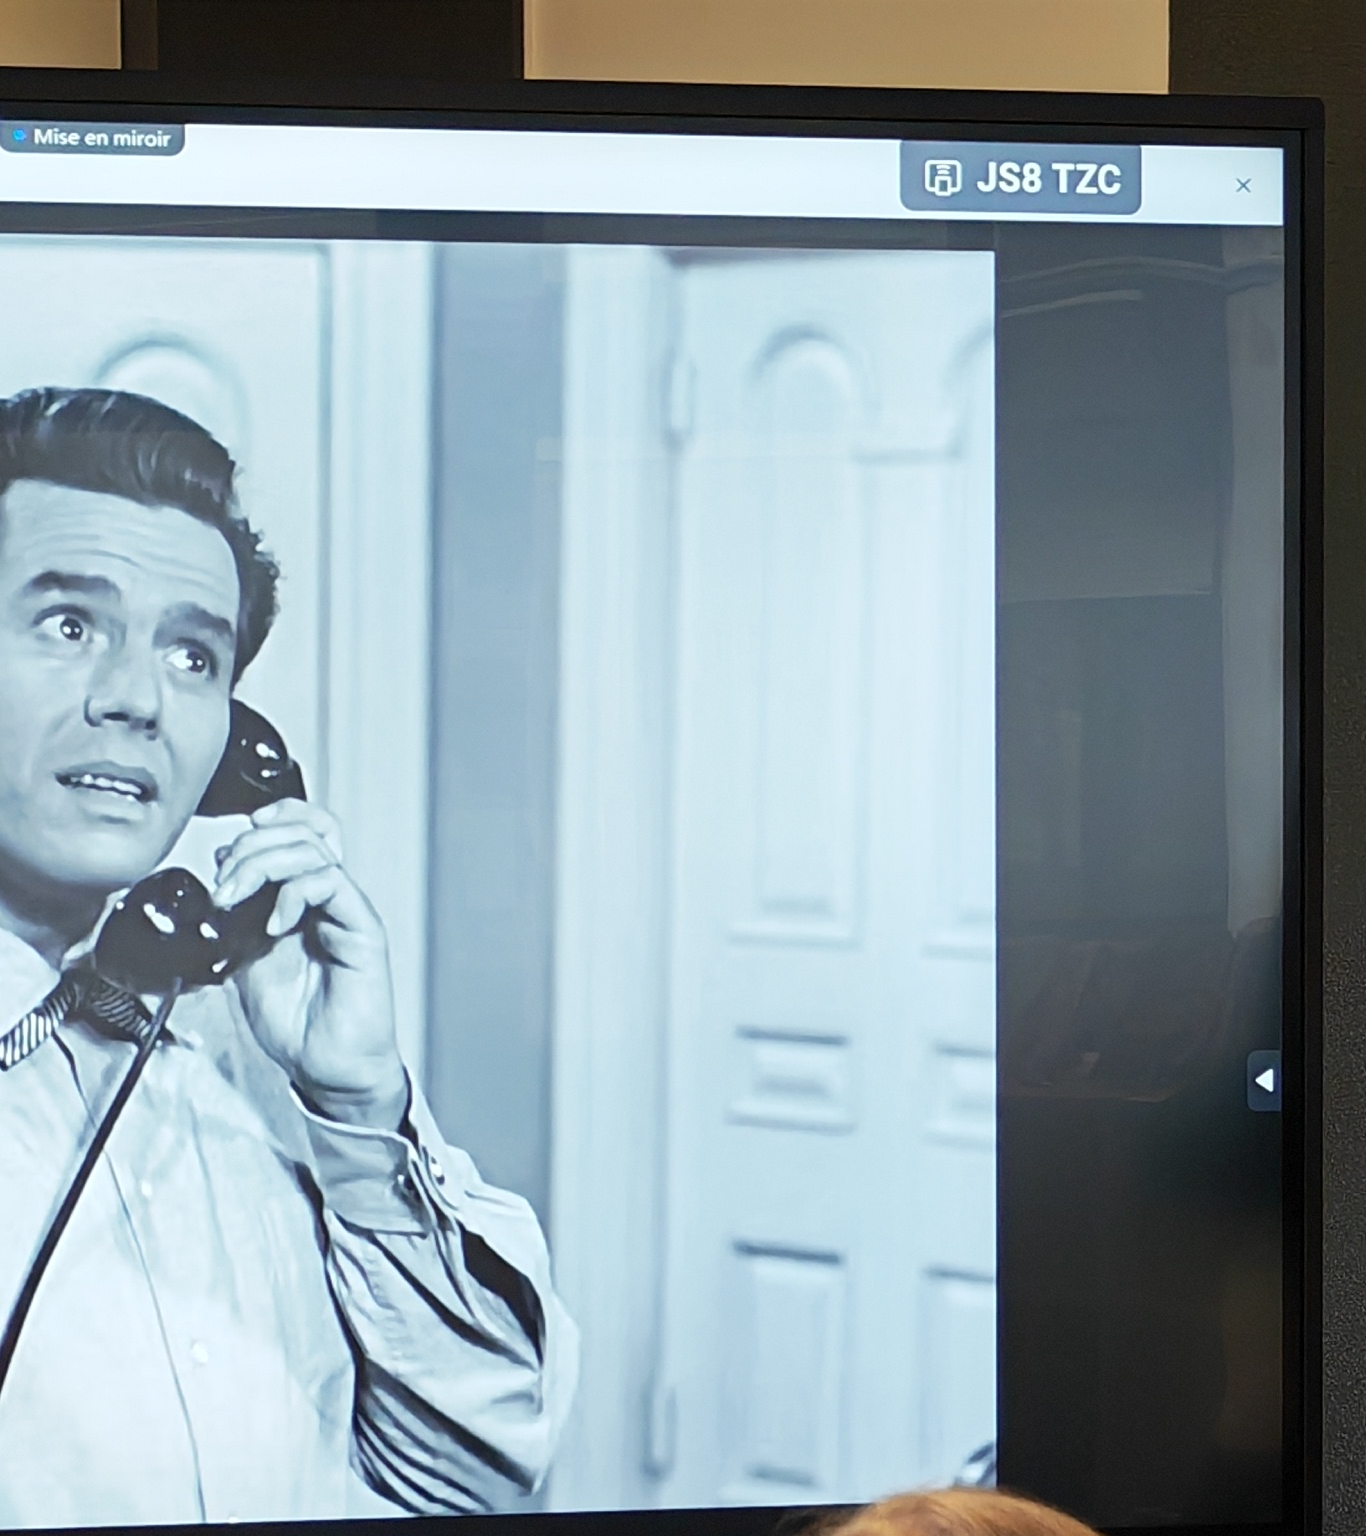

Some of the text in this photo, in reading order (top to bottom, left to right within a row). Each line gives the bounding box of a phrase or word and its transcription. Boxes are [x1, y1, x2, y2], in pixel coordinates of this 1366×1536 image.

[34, 128, 172, 148] Mise en miroir
[976, 160, 1122, 195] JS8 TZC
